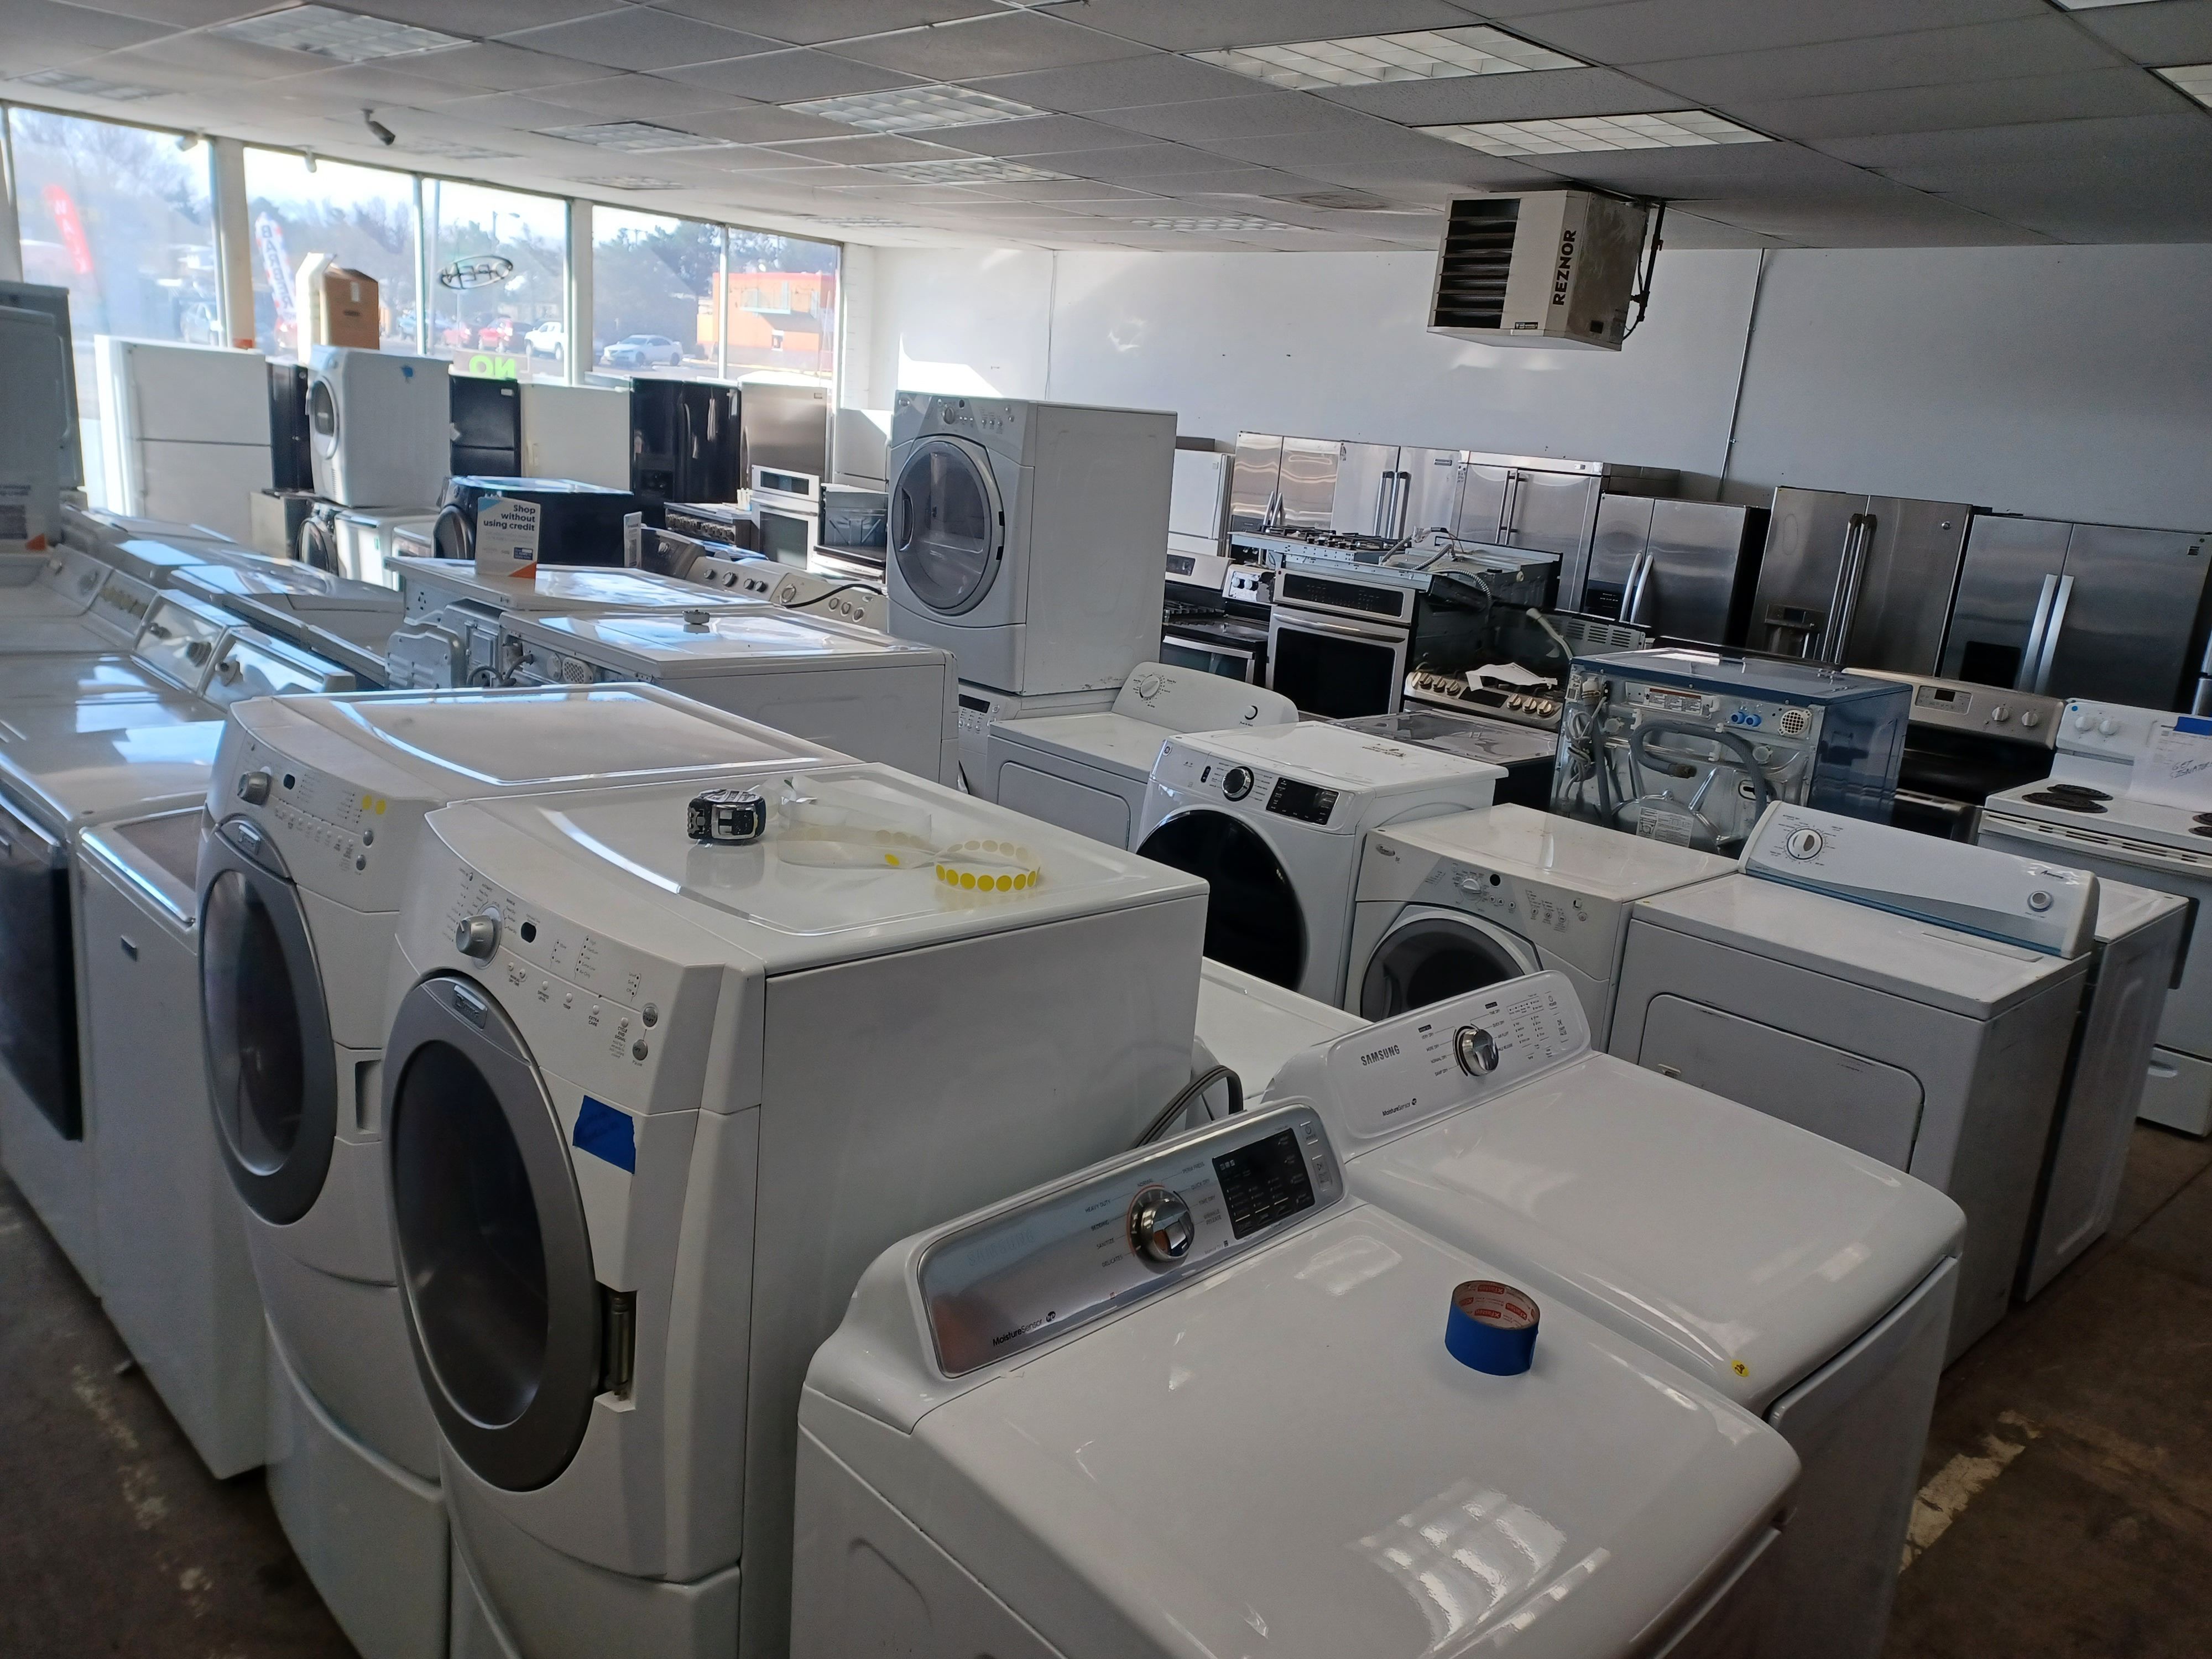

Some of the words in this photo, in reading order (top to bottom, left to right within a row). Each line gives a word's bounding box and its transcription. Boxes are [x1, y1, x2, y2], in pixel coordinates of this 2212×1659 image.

[1552, 229, 1577, 306] REZNOR
[513, 504, 536, 515] Shop
[501, 512, 535, 523] without
[483, 519, 507, 530] using
[509, 523, 535, 531] credit
[588, 1015, 600, 1023] EXTRA
[617, 1025, 628, 1034] CYCLE
[1360, 1045, 1400, 1066] SAMSUNG
[1382, 1102, 1411, 1117] MoistureSensor
[1193, 1161, 1206, 1170] PRESS
[1136, 1178, 1154, 1187] NORMAL
[1191, 1182, 1203, 1190] QUICK
[1202, 1178, 1211, 1186] DRY
[1207, 1194, 1216, 1203] DRY
[1084, 1204, 1099, 1213] HEAVY
[1100, 1199, 1111, 1208] DUTY
[1091, 1219, 1110, 1232] BEDDING
[1096, 1237, 1115, 1250] SANITIZE
[1101, 1254, 1124, 1268] DELICATES
[992, 1318, 1043, 1347] MoistureSensor
